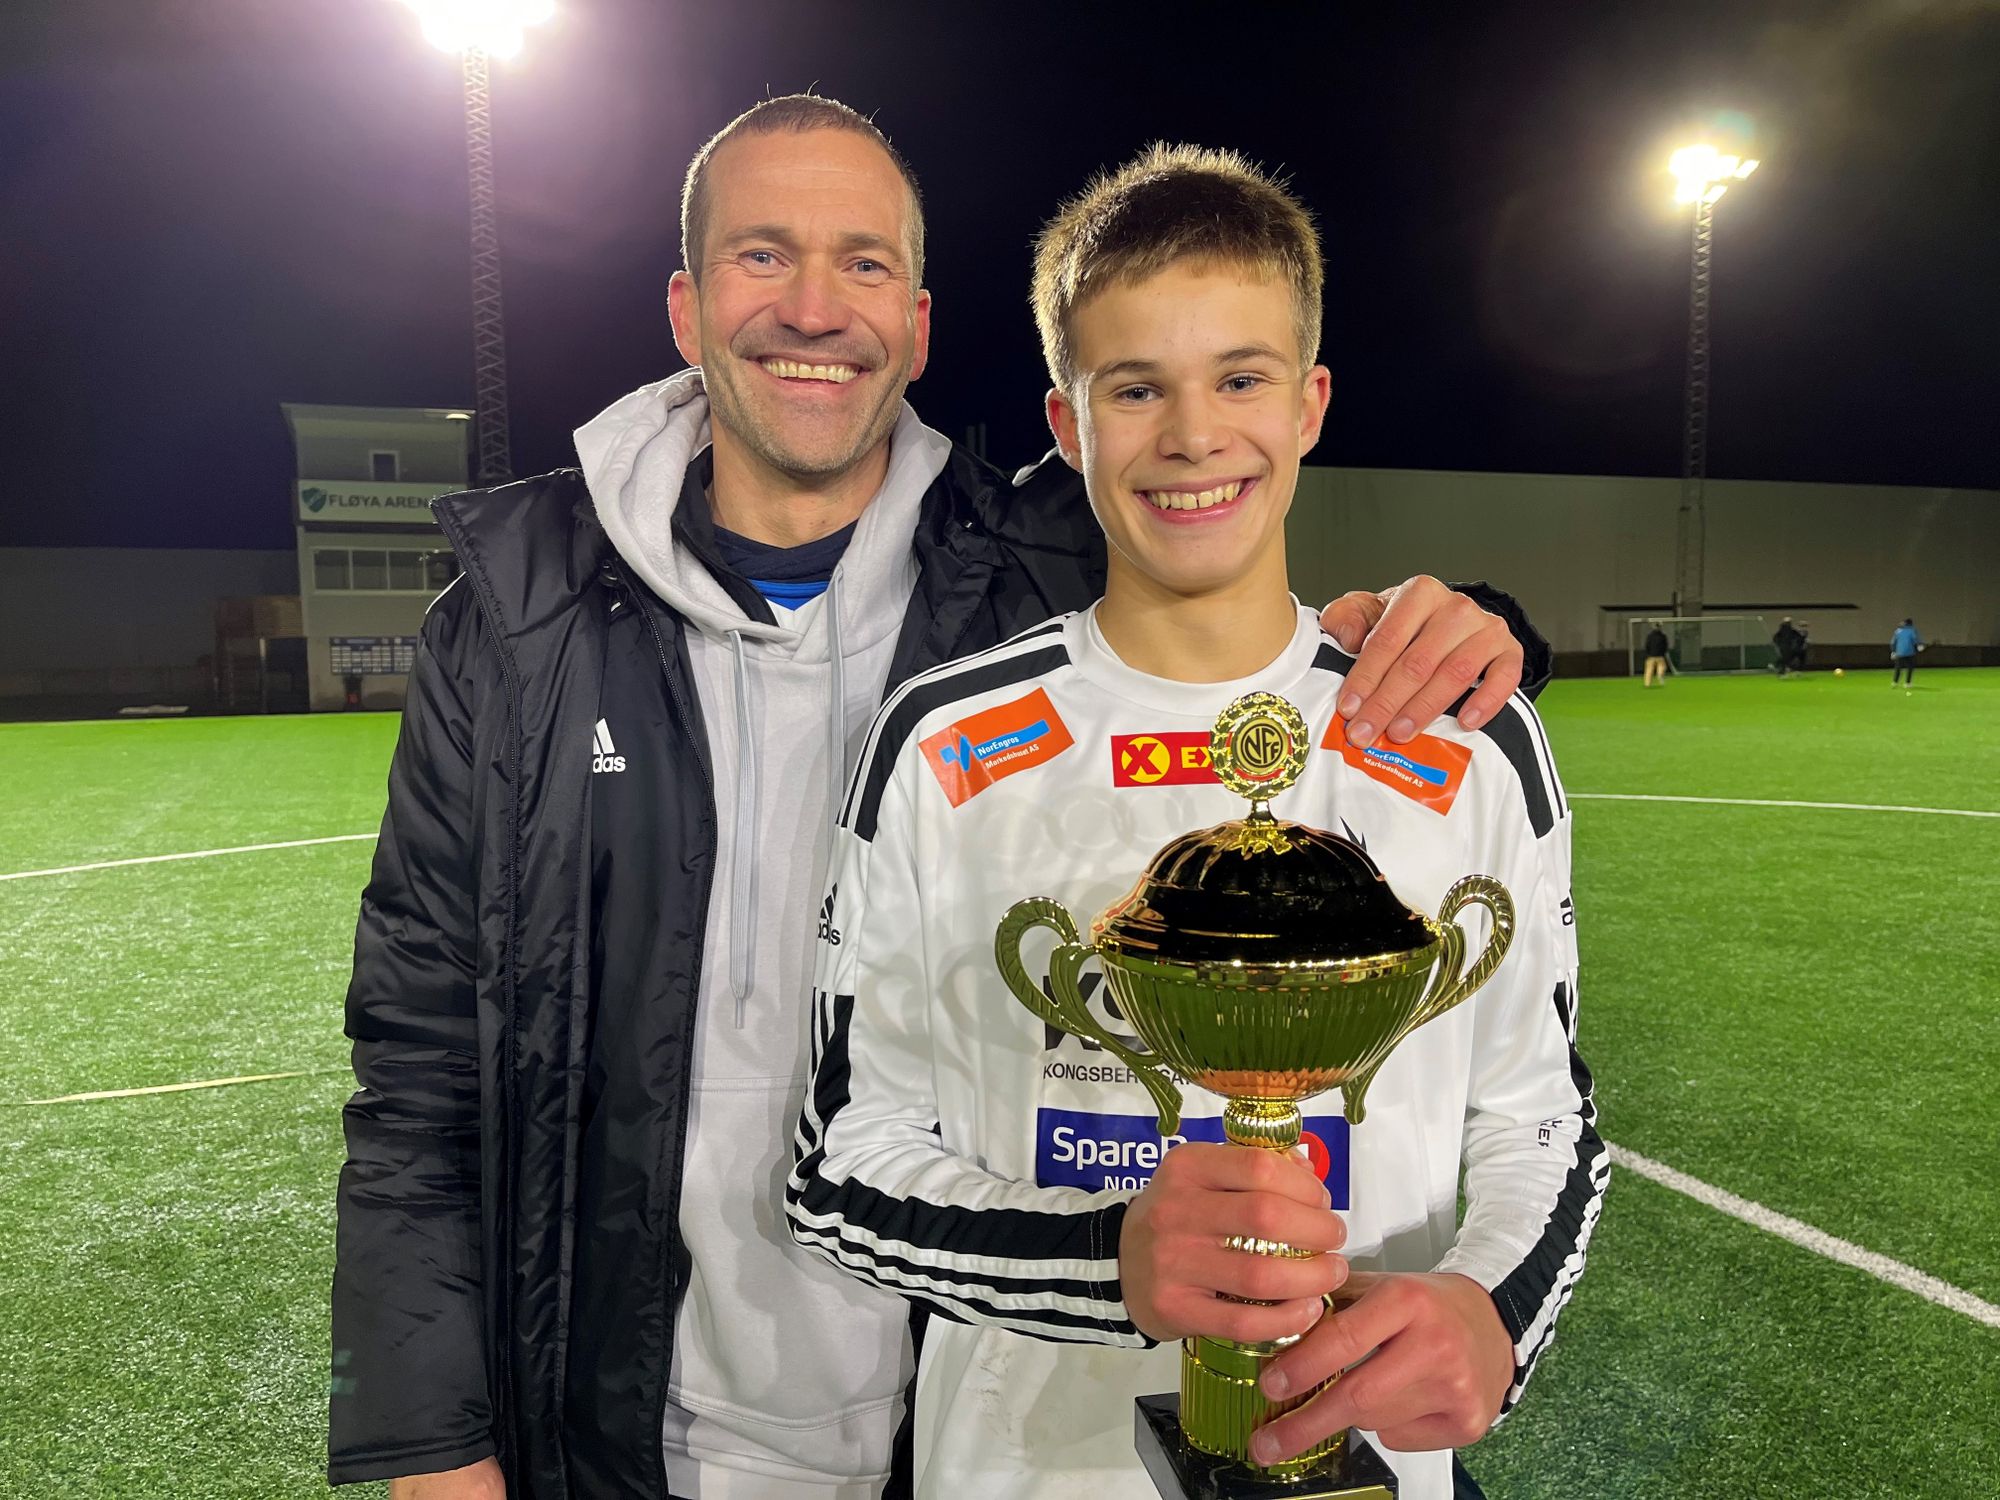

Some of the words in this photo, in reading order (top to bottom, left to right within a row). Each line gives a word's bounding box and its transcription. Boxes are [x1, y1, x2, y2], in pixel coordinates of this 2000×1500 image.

[329, 494, 380, 507] FLØYA
[384, 496, 429, 509] AREN
[977, 736, 1020, 756] NorEngros
[985, 748, 1030, 769] Markedshuset
[1029, 743, 1040, 753] AS
[1363, 757, 1412, 782] Markedshuset
[1412, 778, 1424, 788] AS
[1043, 1062, 1140, 1084] KONGSBER
